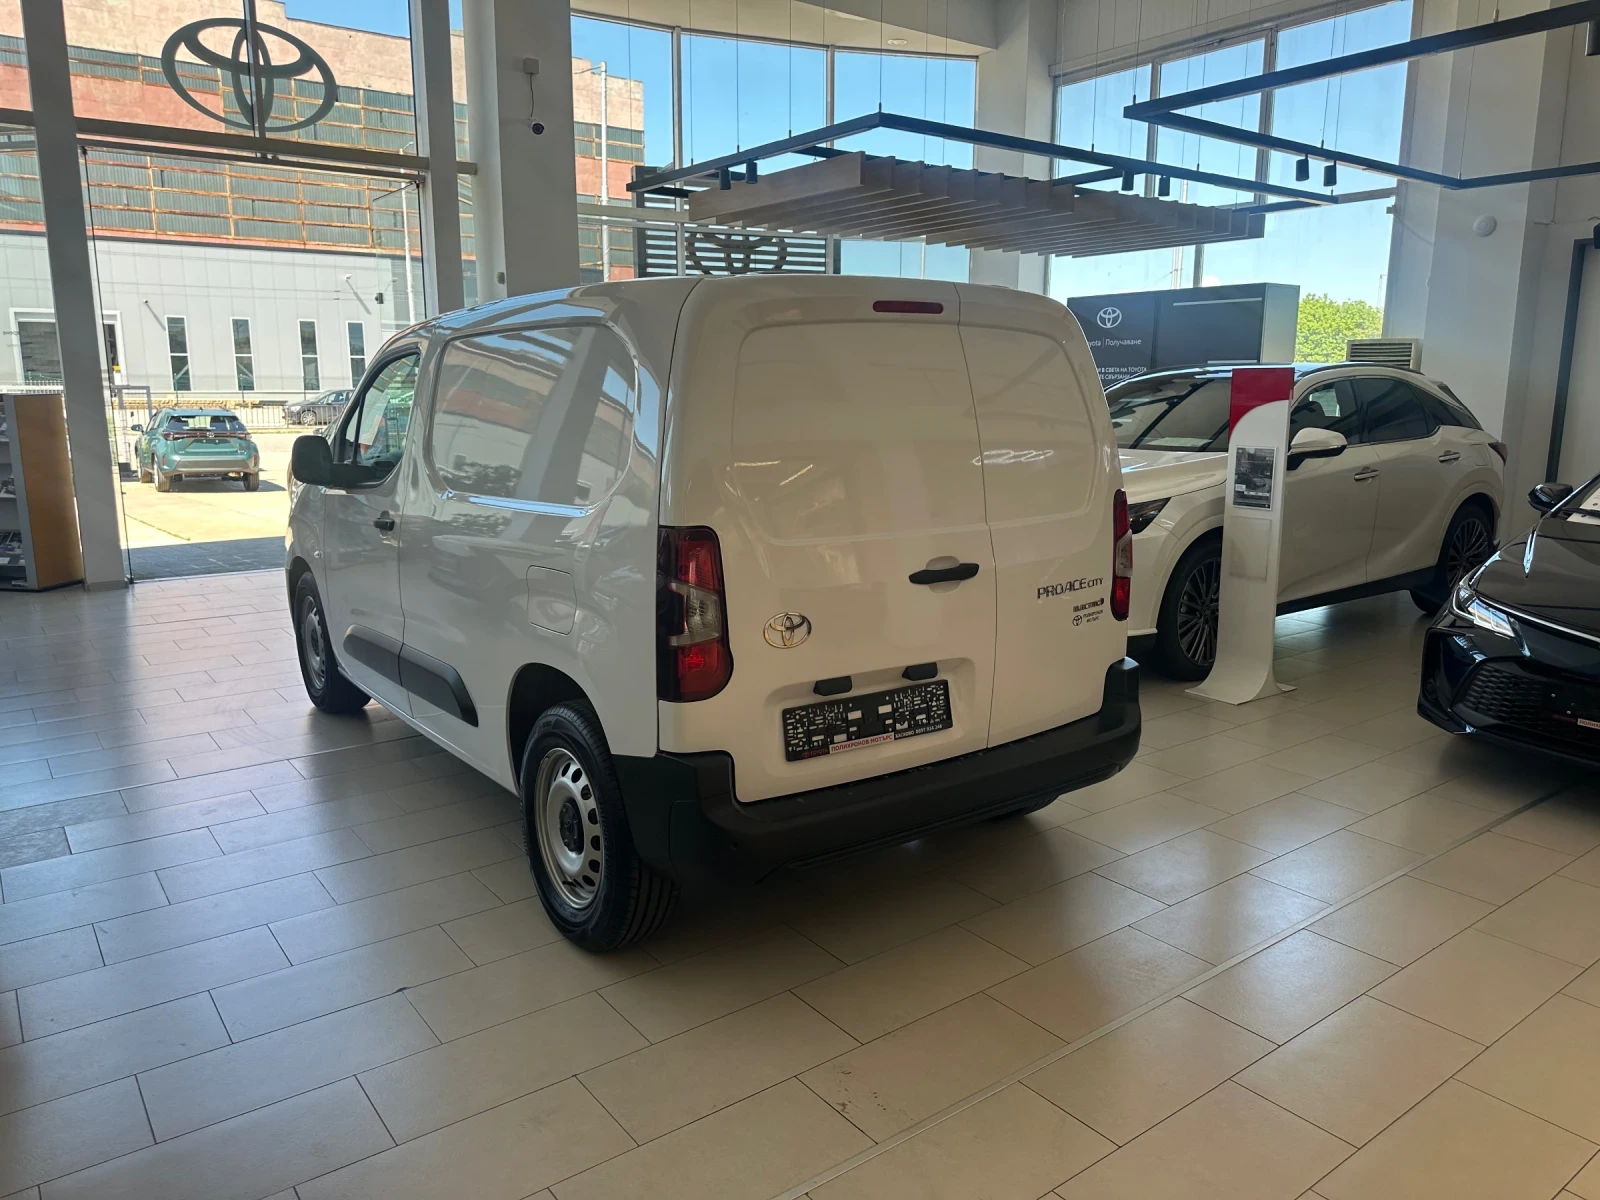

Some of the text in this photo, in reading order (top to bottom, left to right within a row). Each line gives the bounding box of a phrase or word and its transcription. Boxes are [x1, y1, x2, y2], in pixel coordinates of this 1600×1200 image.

[1105, 339, 1142, 347] Получаване
[1037, 577, 1104, 599] PROACE CITY
[831, 739, 870, 752] ПОЛИХРОНОВ
[870, 734, 893, 744] МОТЪРС
